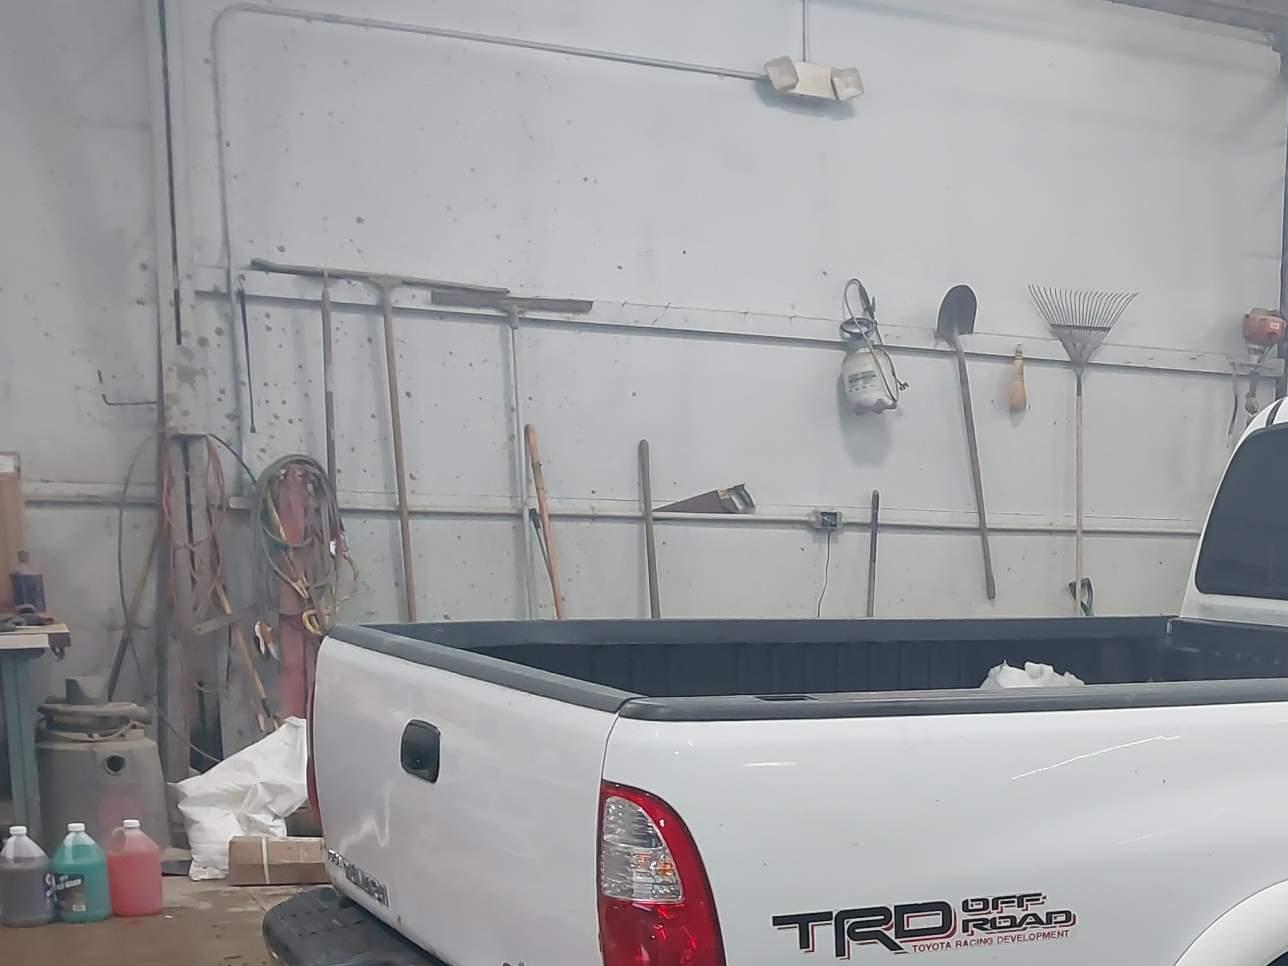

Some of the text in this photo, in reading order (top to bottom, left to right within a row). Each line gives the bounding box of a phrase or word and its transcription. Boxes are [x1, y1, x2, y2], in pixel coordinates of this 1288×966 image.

[961, 892, 1047, 916] OFF
[772, 899, 957, 960] TRD
[961, 909, 1077, 936] ROAD
[911, 929, 1071, 954] TOYOTA RACING DEVELOPMENT
